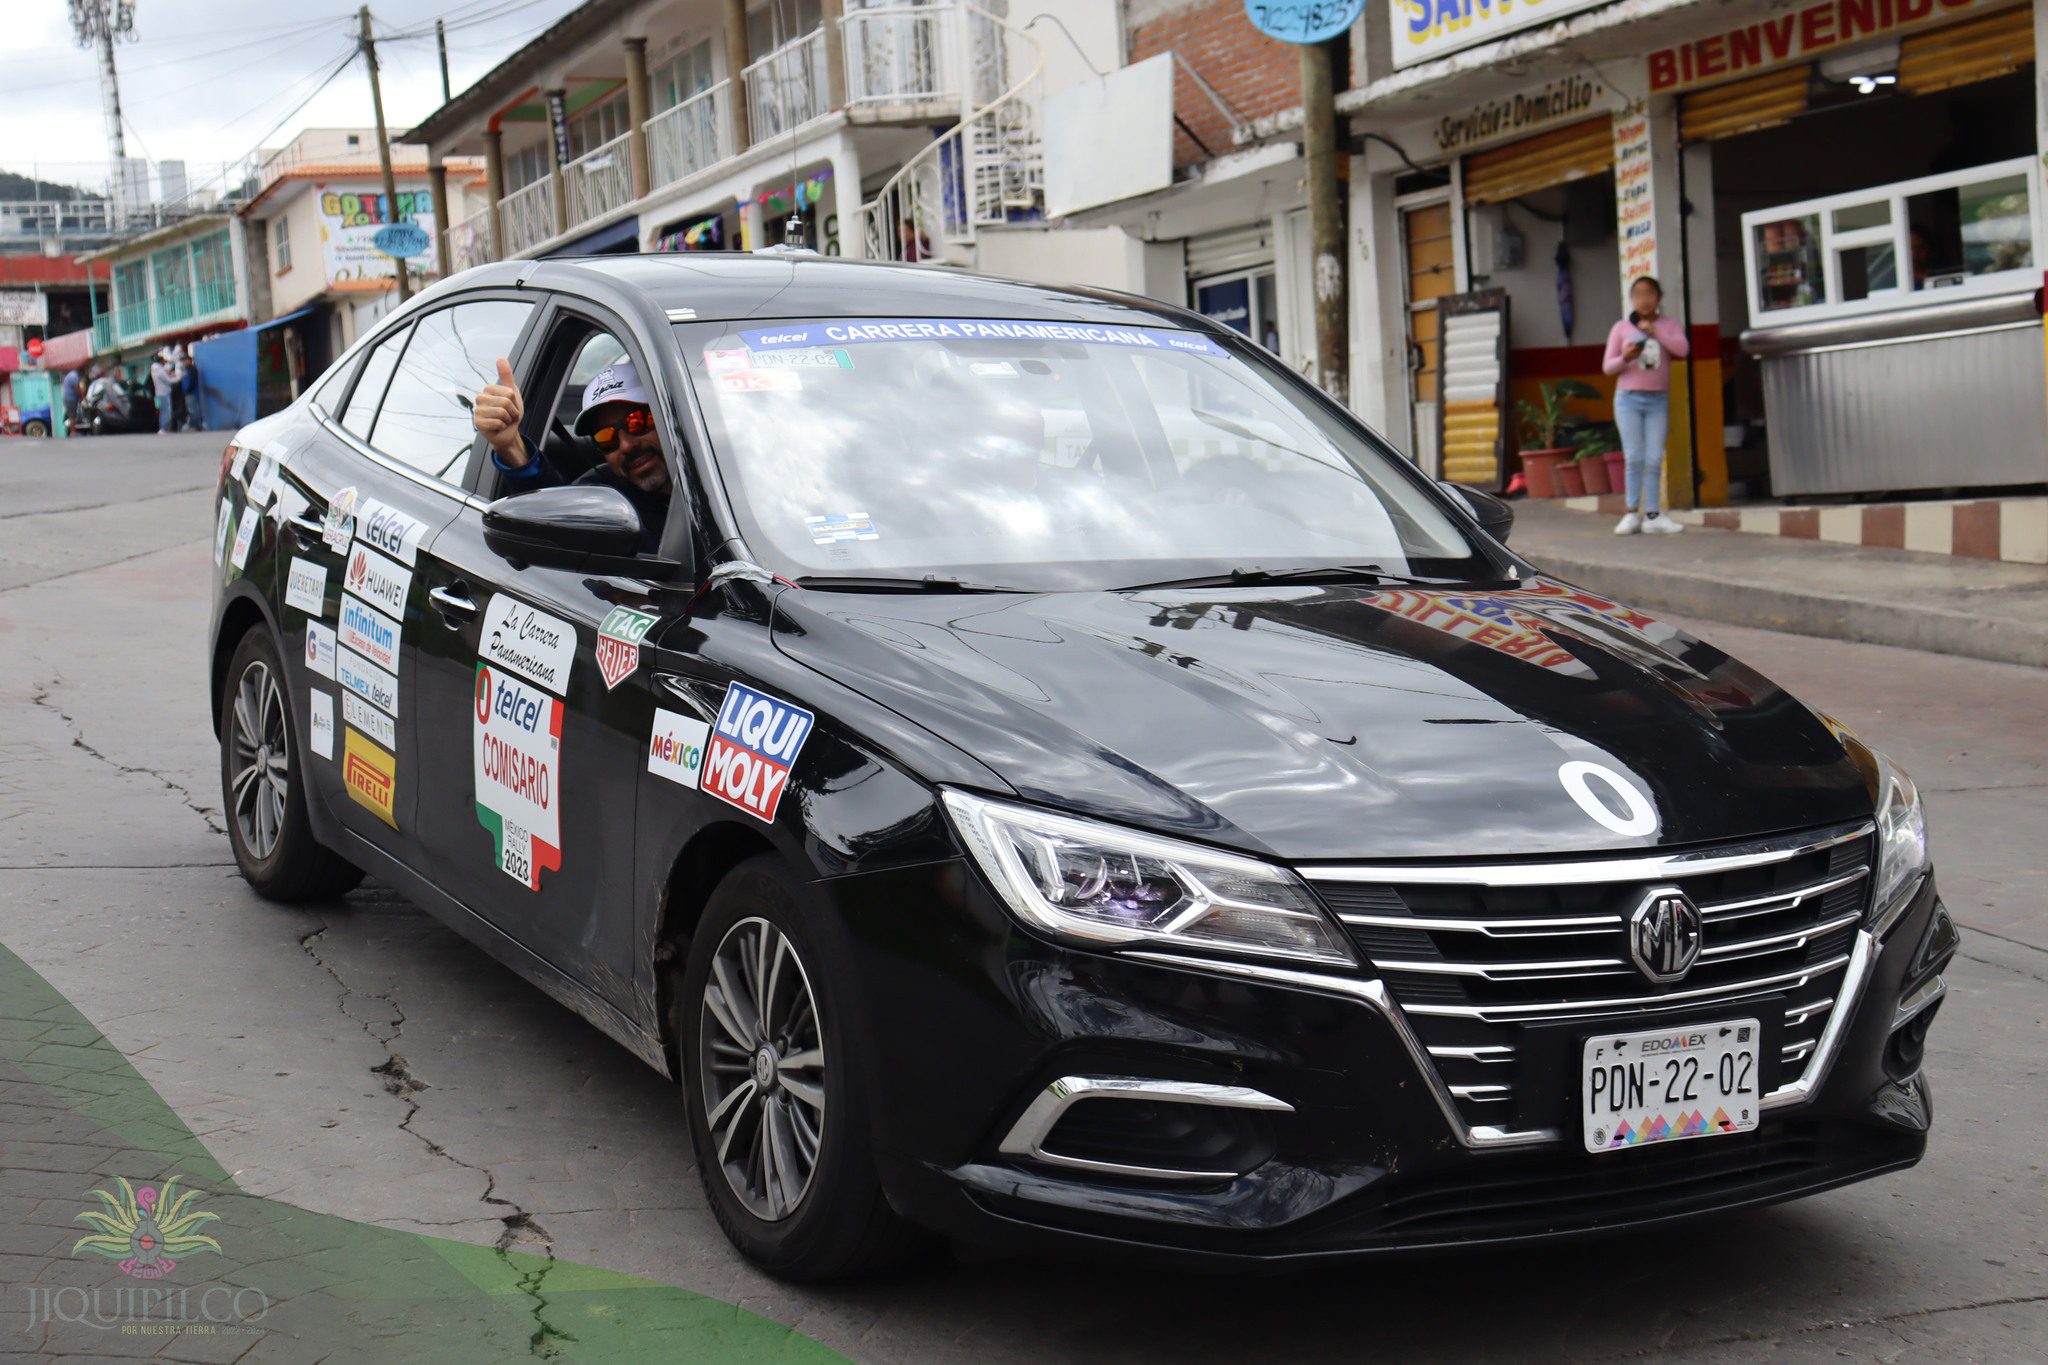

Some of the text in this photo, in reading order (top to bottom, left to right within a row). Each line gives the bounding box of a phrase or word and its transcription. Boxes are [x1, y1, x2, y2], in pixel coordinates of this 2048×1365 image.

[1647, 0, 1974, 92] BIENVENID
[760, 323, 1208, 351] telcel CARRERA PANAMERICANA telcel
[592, 381, 624, 400] Spirit
[366, 506, 416, 554] telcel
[366, 569, 404, 608] HUAWEI
[344, 600, 393, 650] infinitum
[502, 604, 561, 650] La Carrera
[608, 611, 651, 640] TAG
[599, 635, 638, 683] HEUER
[341, 668, 393, 710] TELMEX telcel
[494, 679, 544, 734] telcel
[718, 689, 809, 762] LIQUI
[347, 751, 391, 808] PIRELLI
[483, 732, 549, 810] COMISARIO
[705, 740, 788, 813] MOLY
[504, 848, 529, 882] 2023
[507, 834, 527, 856] RALLY
[1643, 900, 1699, 972] MG
[1591, 1051, 1753, 1114] PDN-22-02
